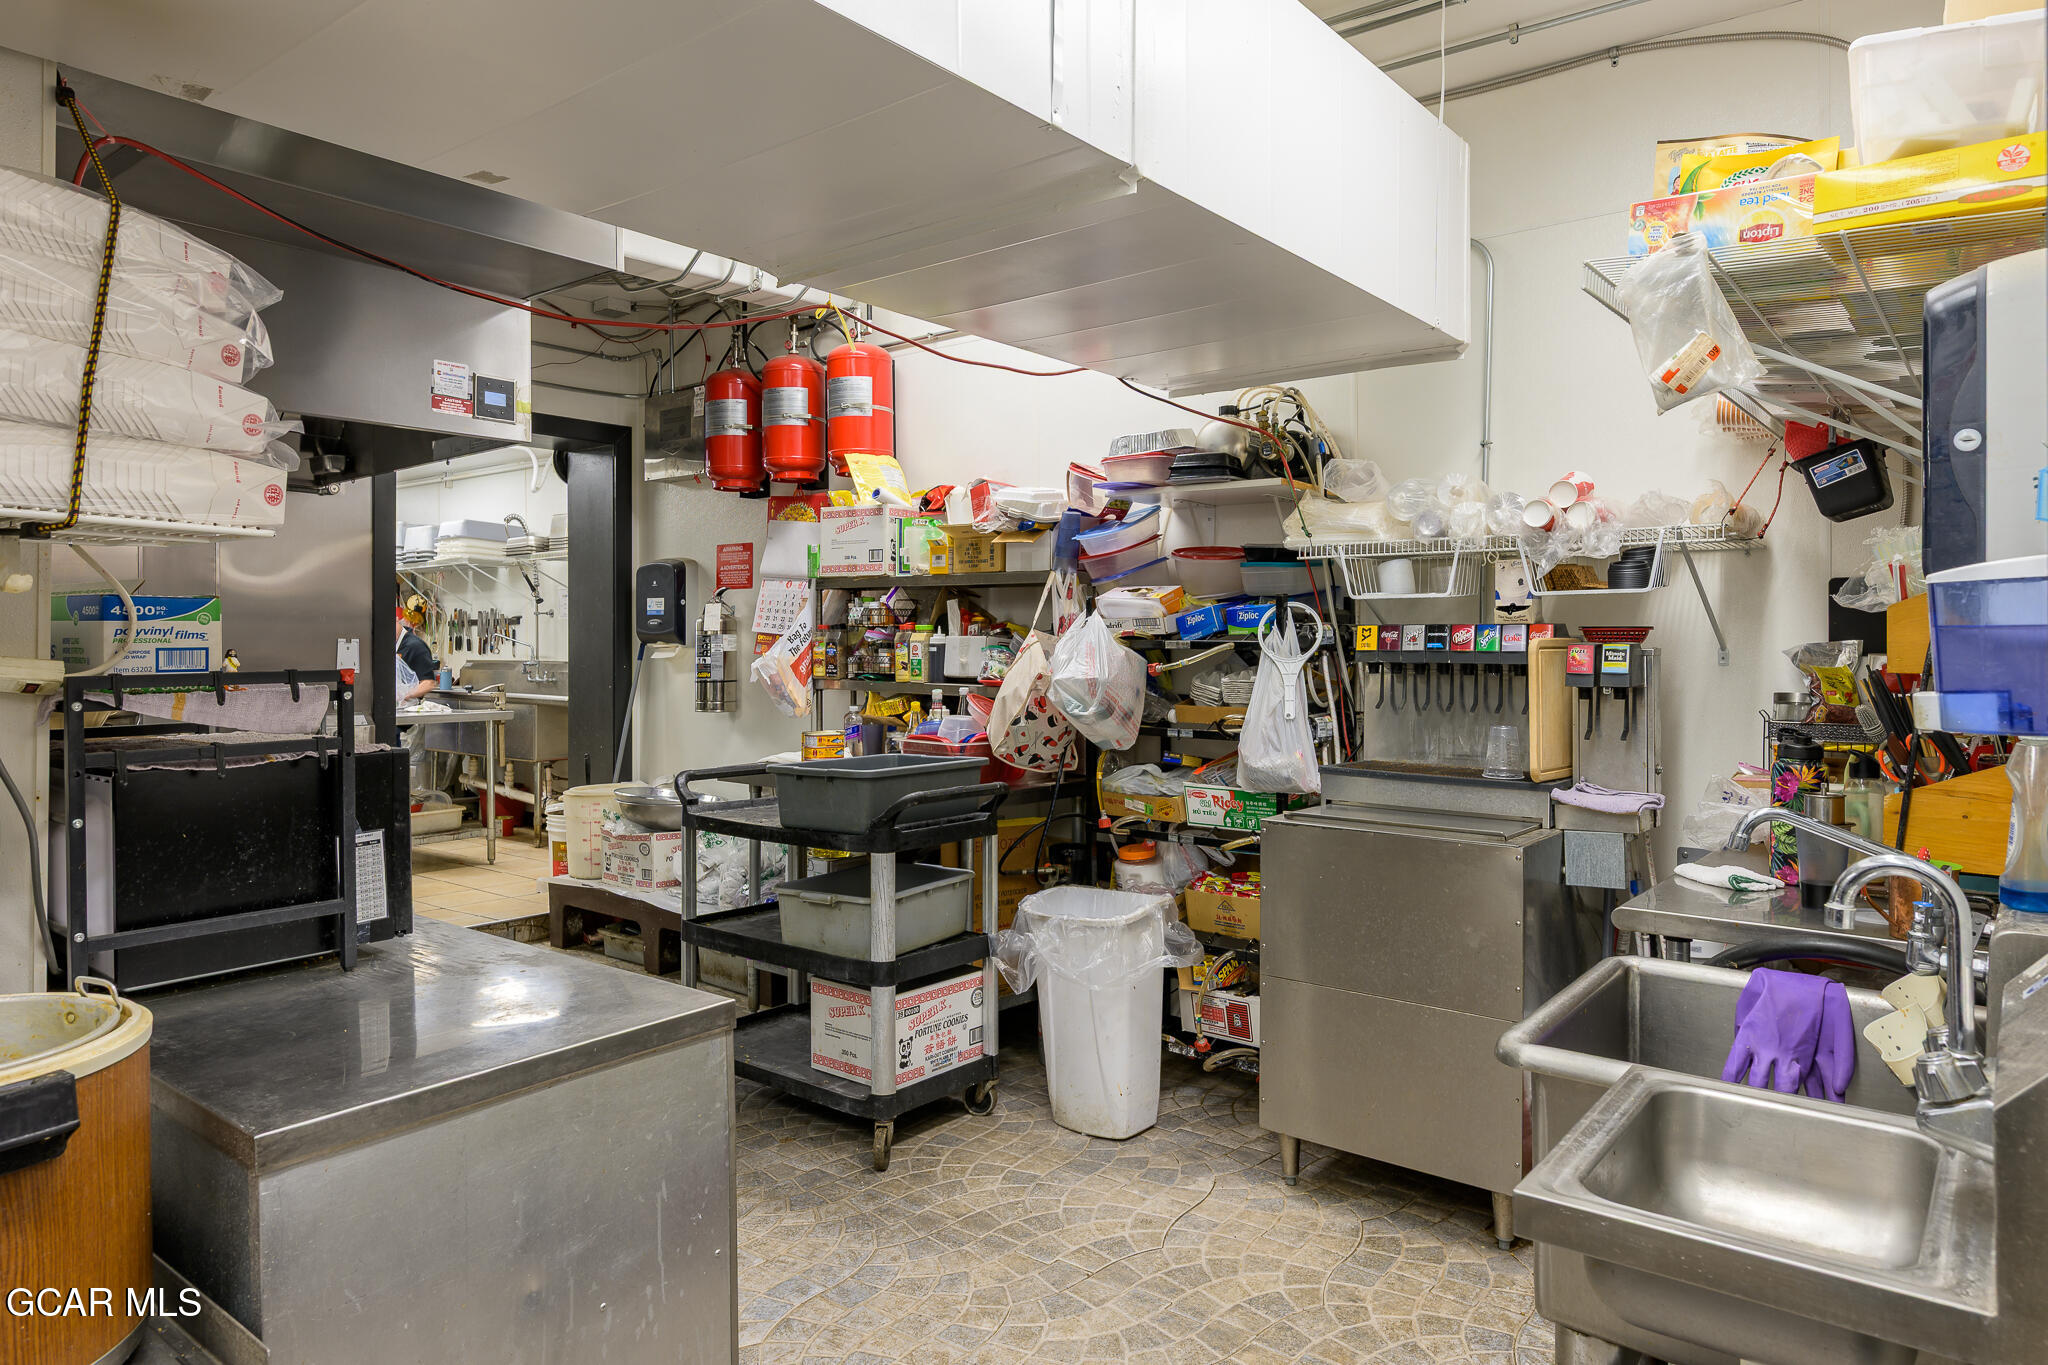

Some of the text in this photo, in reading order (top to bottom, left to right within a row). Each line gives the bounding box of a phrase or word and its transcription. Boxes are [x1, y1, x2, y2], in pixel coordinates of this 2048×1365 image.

[1739, 197, 1760, 206] tea
[1863, 205, 1880, 213] 200
[1743, 225, 1781, 240] Lipton
[1186, 614, 1206, 626] Ziploc
[1238, 612, 1259, 621] Ziploc
[113, 626, 207, 641] poyvinyl films
[787, 622, 807, 644] Bag To
[1480, 630, 1496, 648] Sprite
[1503, 634, 1522, 642] Coke
[788, 645, 801, 657] The
[1211, 795, 1244, 812] Ricey
[1217, 958, 1239, 982] SPAM
[829, 1005, 866, 1018] SUPER K
[907, 999, 948, 1030] SUPER K
[914, 1020, 942, 1039] FORTUNE
[943, 1014, 969, 1030] COOKIES
